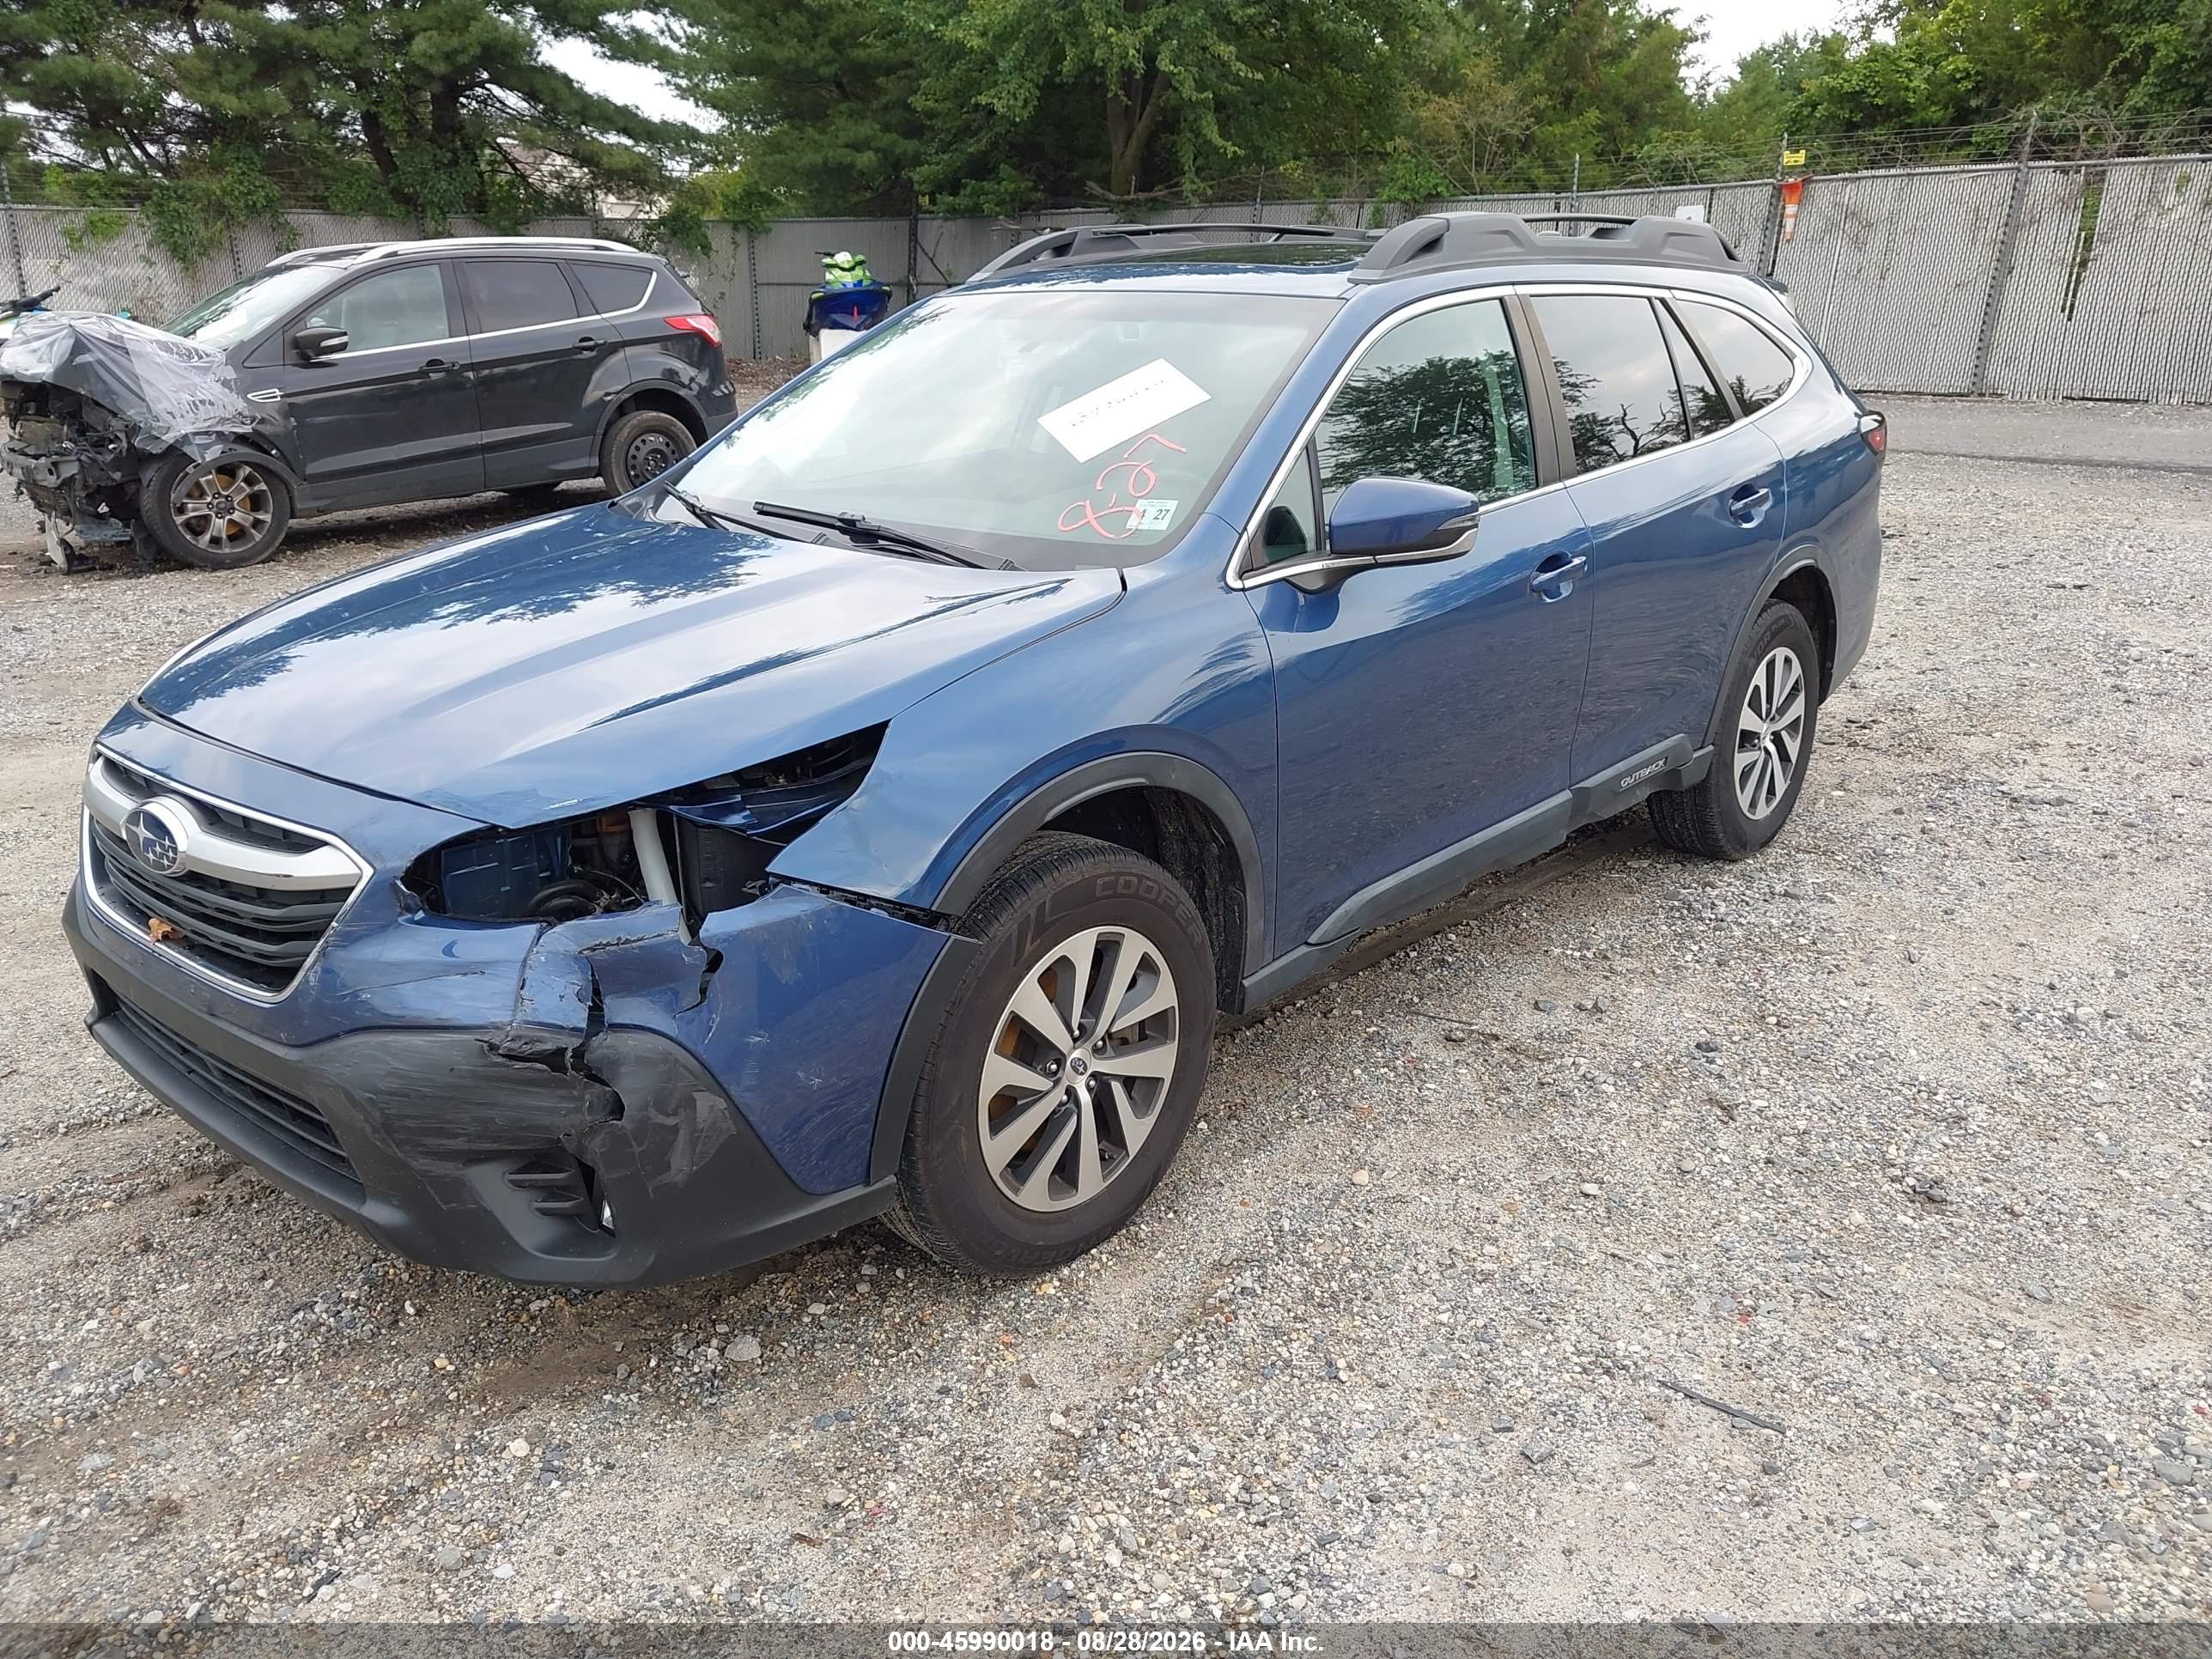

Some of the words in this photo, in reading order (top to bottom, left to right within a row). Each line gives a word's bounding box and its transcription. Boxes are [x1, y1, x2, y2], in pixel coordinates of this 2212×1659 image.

[1152, 508, 1170, 520] 27
[1620, 757, 1668, 788] OUTBACK
[1095, 875, 1203, 949] COOPER
